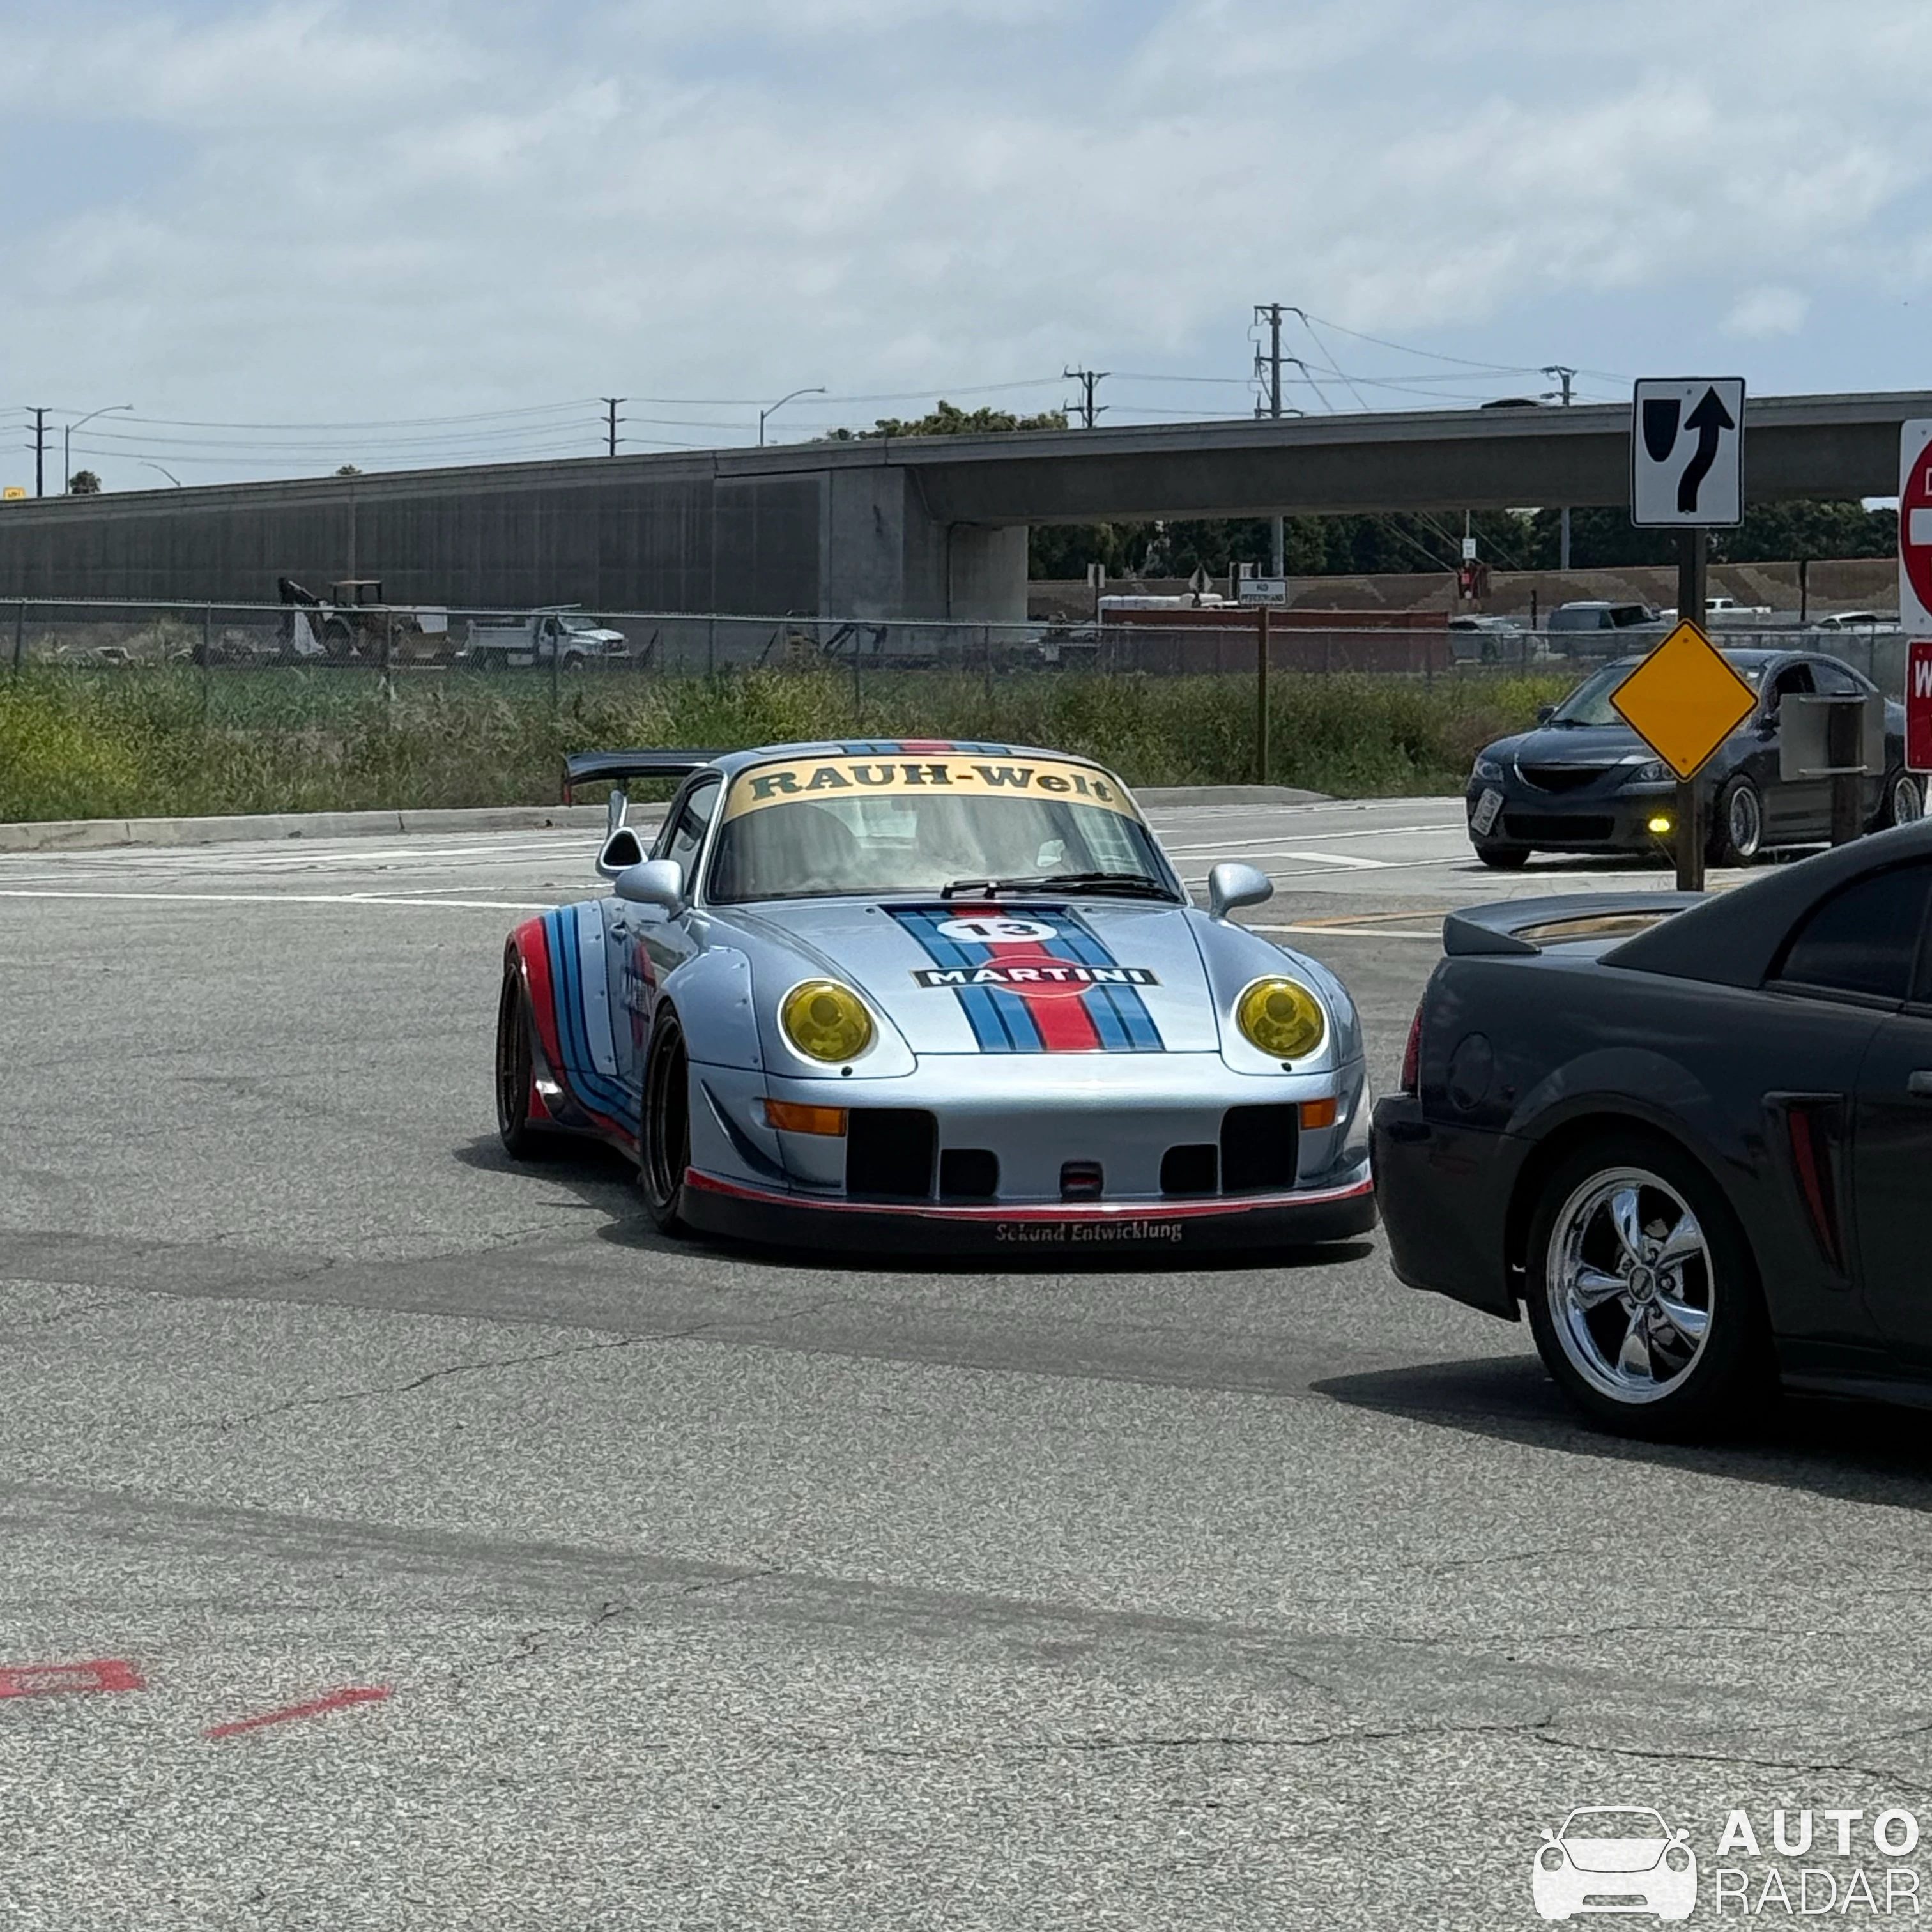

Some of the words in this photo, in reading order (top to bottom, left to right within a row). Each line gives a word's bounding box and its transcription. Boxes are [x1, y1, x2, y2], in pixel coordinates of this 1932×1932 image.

[749, 764, 1113, 802] RAUH-Welt
[956, 924, 1039, 937] 13
[926, 968, 1146, 986] MARTINI
[1071, 1221, 1183, 1243] Entwicklung
